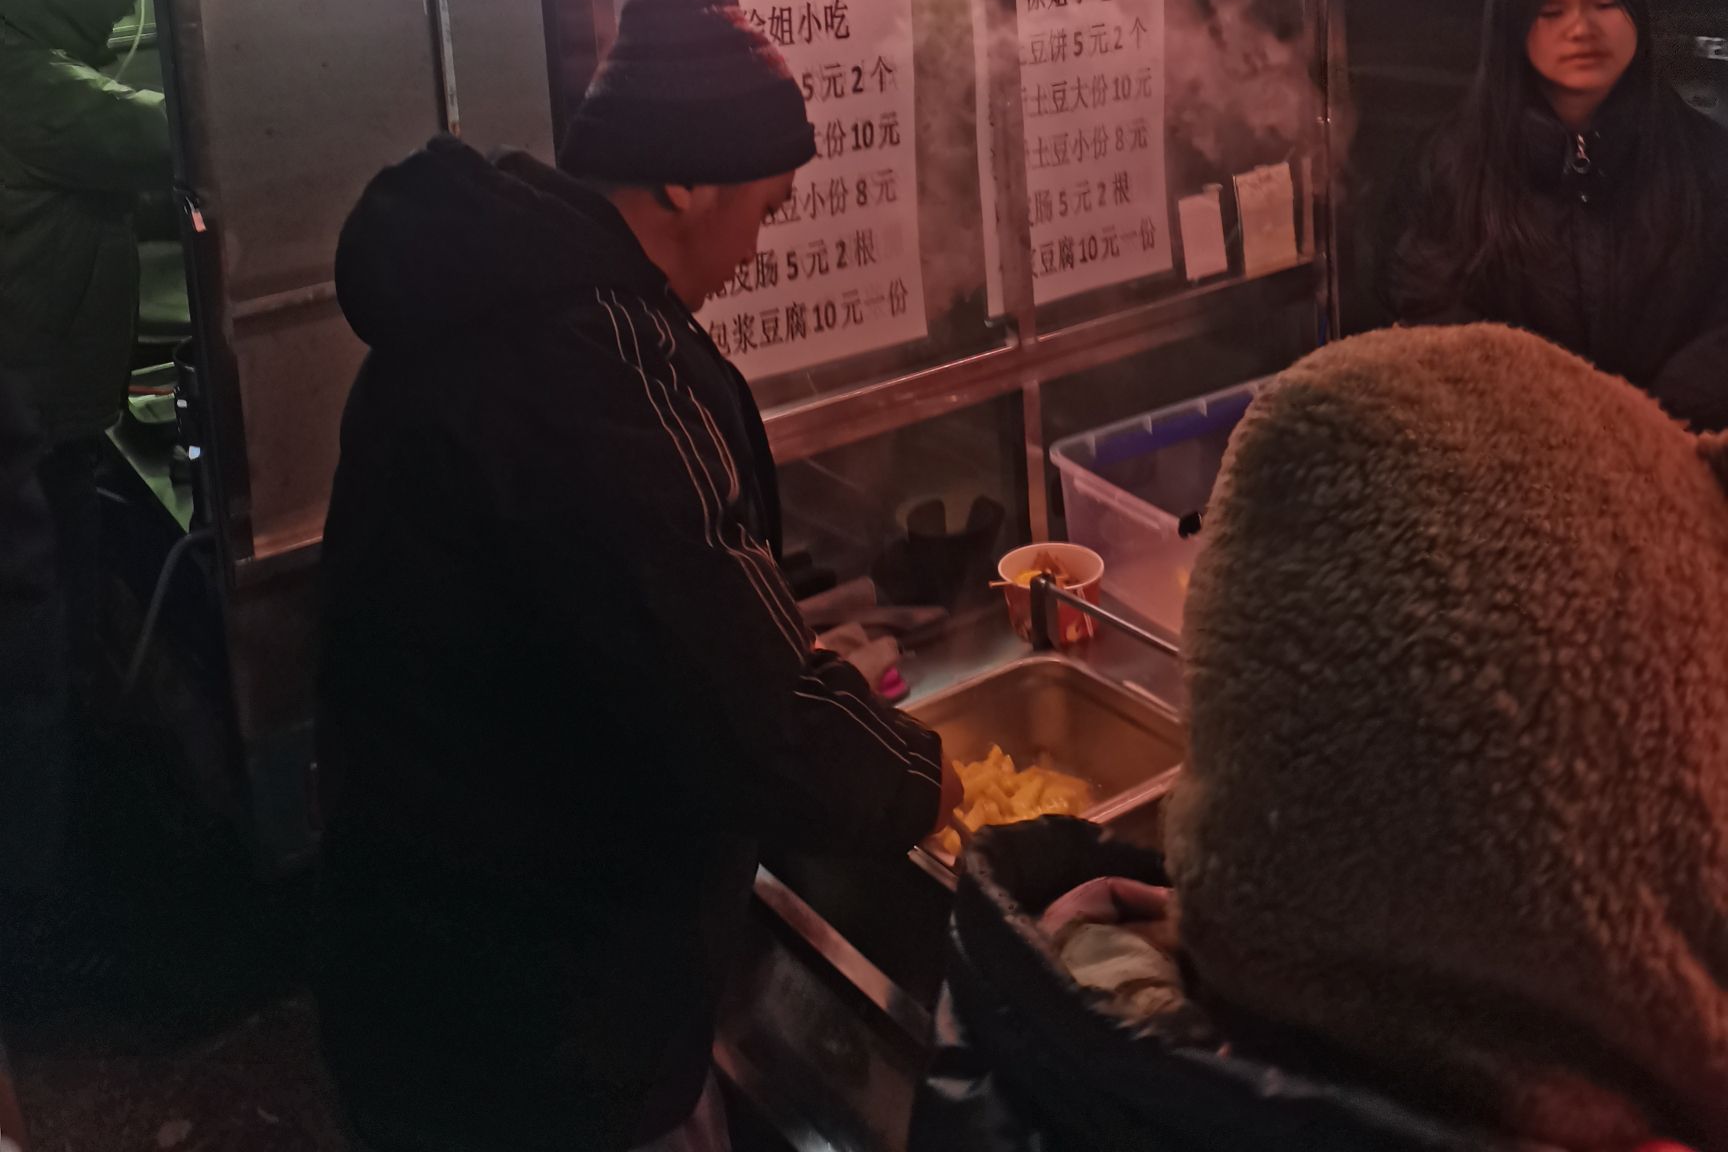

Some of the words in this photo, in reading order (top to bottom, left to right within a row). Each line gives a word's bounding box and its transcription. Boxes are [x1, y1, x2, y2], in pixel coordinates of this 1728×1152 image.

[1022, 67, 1152, 117] 土豆大份10元
[814, 111, 900, 159] 份10元
[1025, 118, 1148, 169] 土豆小份8元
[1030, 170, 1131, 227] 肠5元2根
[704, 229, 876, 302] 皮肠5元2根
